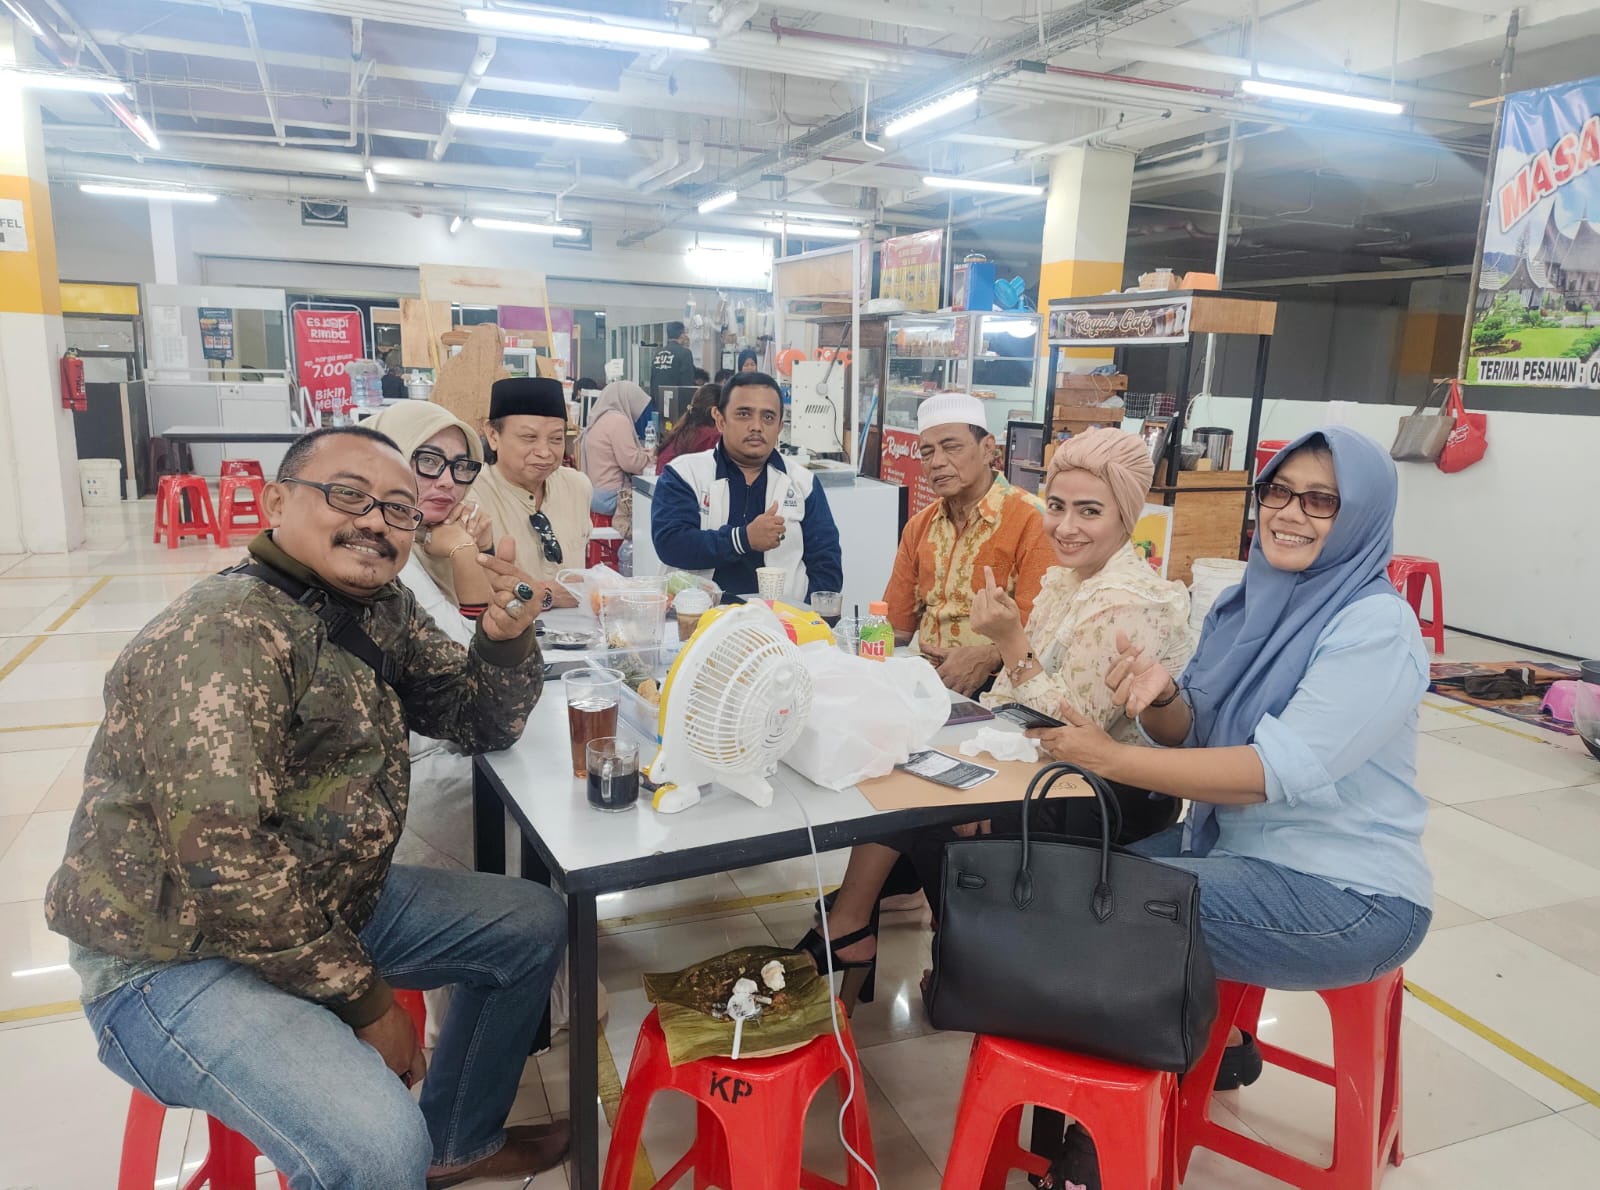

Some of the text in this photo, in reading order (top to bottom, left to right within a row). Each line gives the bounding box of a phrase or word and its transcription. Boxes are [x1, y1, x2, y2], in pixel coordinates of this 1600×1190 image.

[1073, 309, 1152, 338] Royale Cafe
[1480, 360, 1520, 381] TERIMA
[1523, 361, 1577, 382] PESANAN
[710, 1071, 752, 1104] KP
